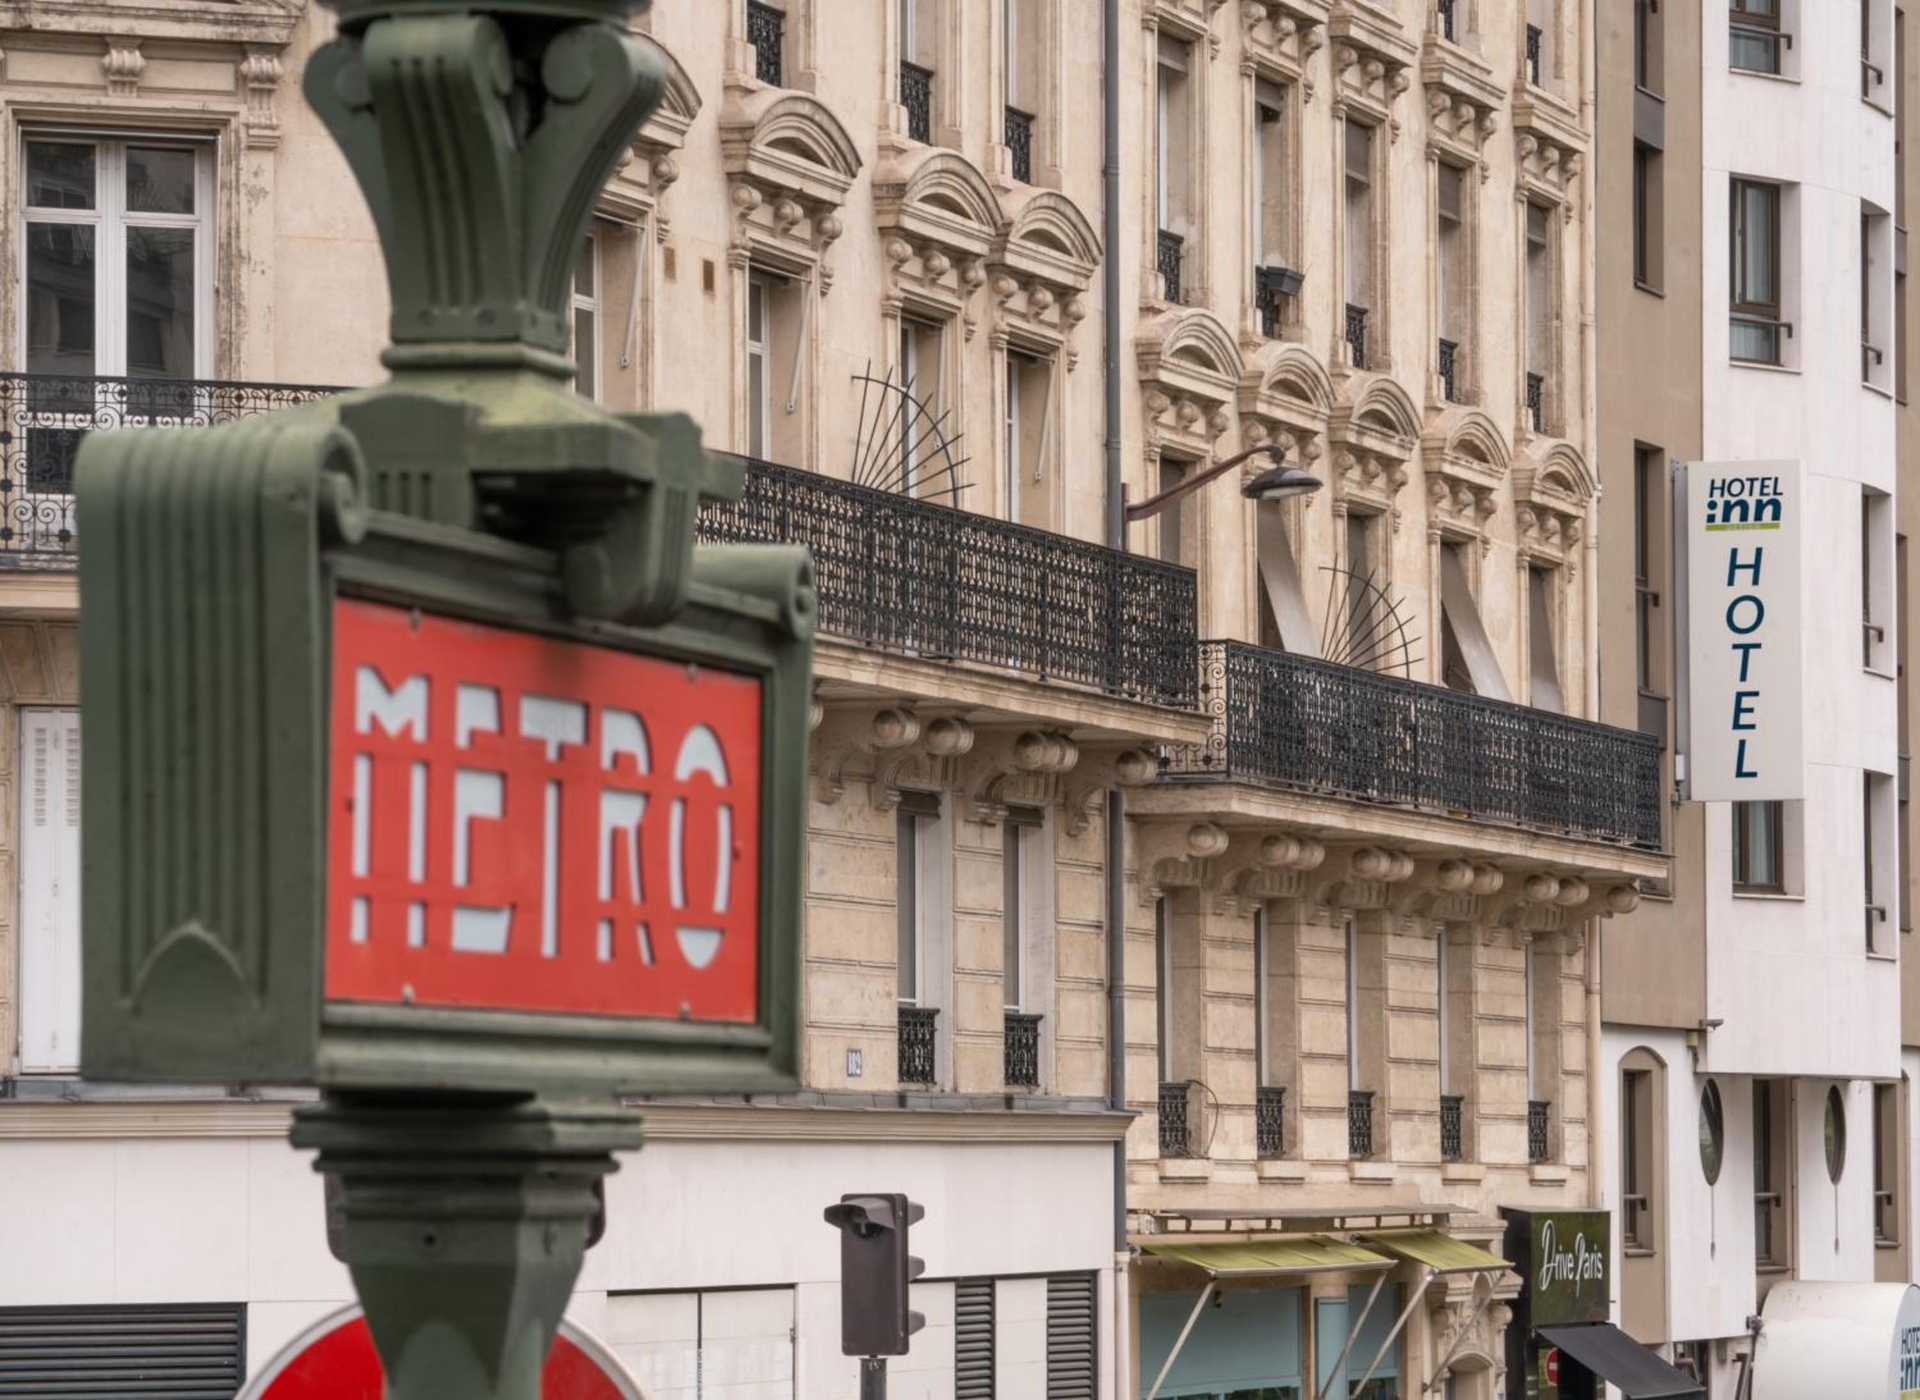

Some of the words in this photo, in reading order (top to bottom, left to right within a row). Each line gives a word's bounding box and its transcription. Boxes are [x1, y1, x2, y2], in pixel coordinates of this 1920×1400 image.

[1706, 498, 1782, 523] inn
[1709, 477, 1783, 498] HOTEL
[1726, 547, 1764, 778] HOTEL
[350, 665, 732, 970] METRO
[1539, 1219, 1574, 1291] Drive
[1575, 1232, 1603, 1298] Paris
